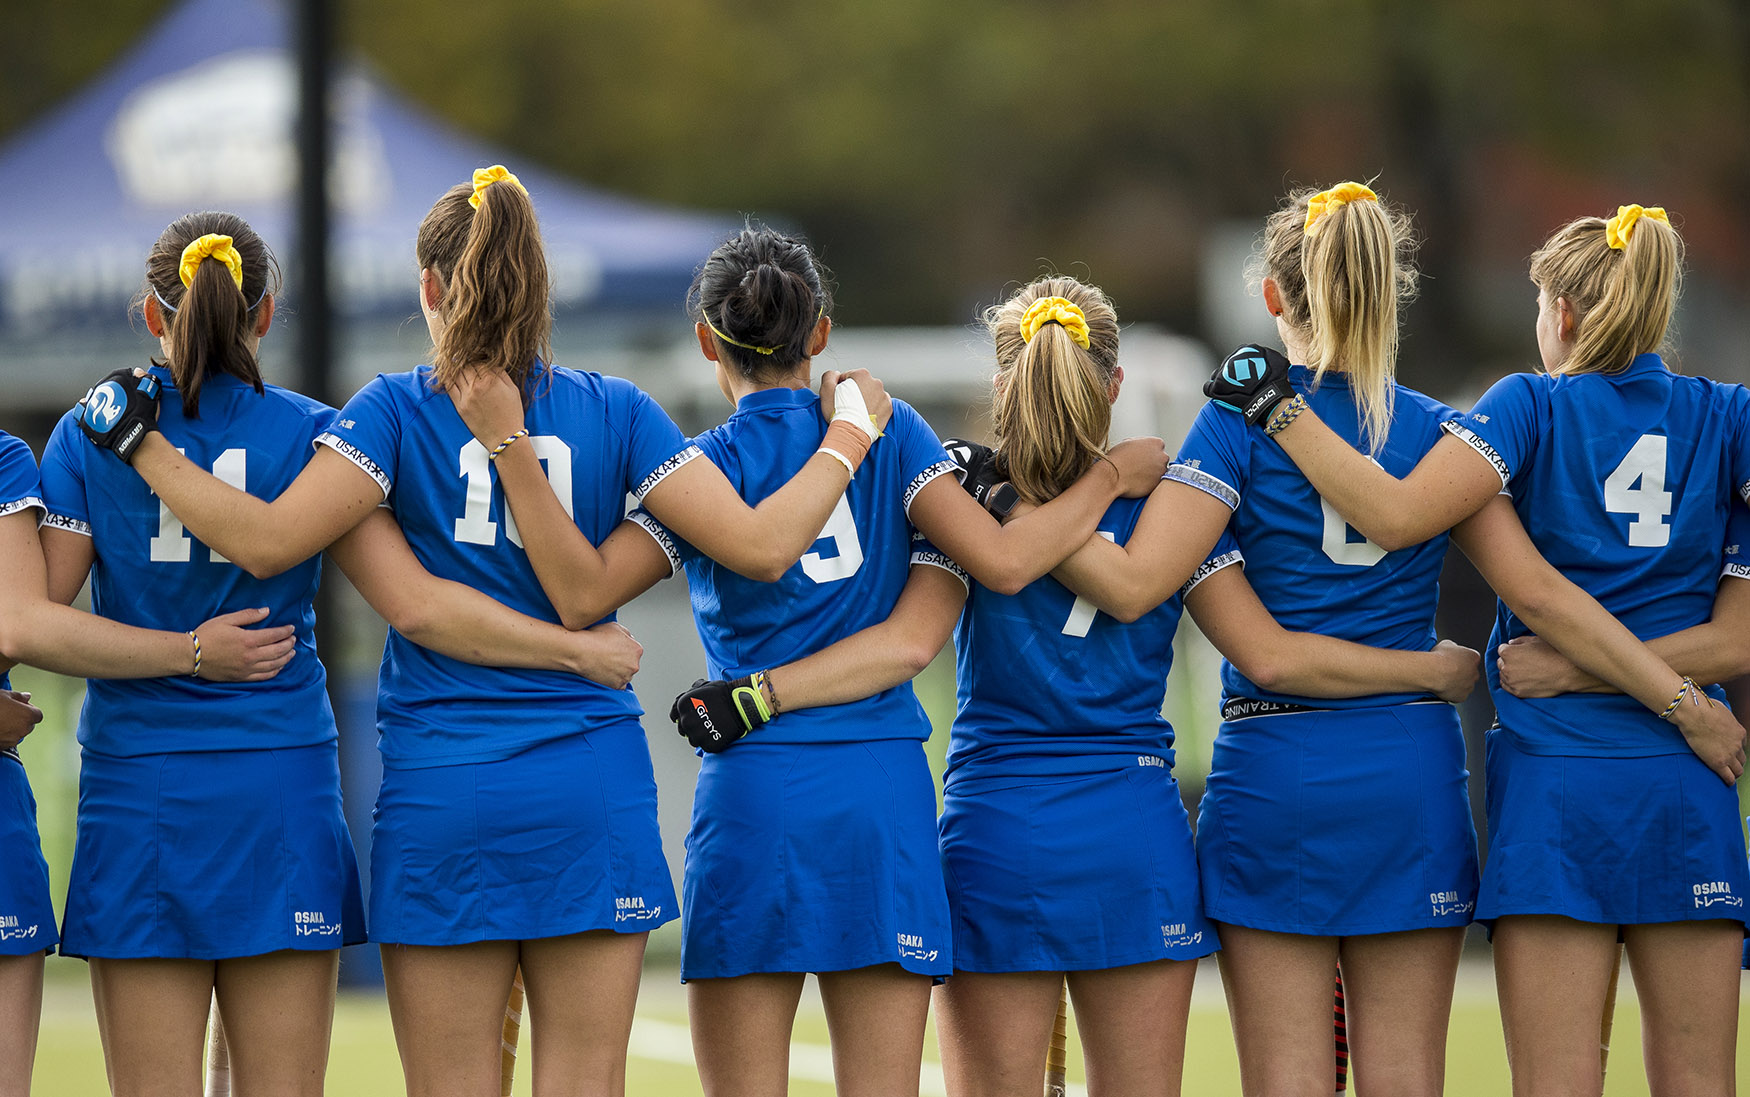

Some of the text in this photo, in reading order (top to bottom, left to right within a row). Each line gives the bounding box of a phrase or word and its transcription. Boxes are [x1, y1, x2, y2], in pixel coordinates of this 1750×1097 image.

[118, 422, 144, 454] GRYPHON
[335, 439, 372, 470] OSAKA
[1468, 434, 1503, 470] OSAKA
[635, 463, 672, 497] OSAKA
[1604, 433, 1672, 547] 4
[643, 517, 675, 554] OSAKA
[918, 551, 959, 573] OSAKA
[1180, 567, 1207, 594] SAKA
[1224, 700, 1280, 720] TRAINING
[1137, 755, 1165, 768] OSAKA
[1693, 881, 1731, 895] OSAKA
[615, 896, 645, 909] OSAKA
[1430, 890, 1458, 904] OSAKA
[1694, 895, 1743, 908] トレーニング
[294, 911, 325, 924] OSAKA
[615, 905, 661, 922] トレーニング
[1432, 901, 1474, 917] トレーニング
[0, 915, 19, 928] SAKA
[295, 923, 342, 936] トレーニング
[0, 924, 38, 940] レーニング
[1163, 930, 1203, 948] トレーニング
[897, 944, 938, 962] トレーニング
